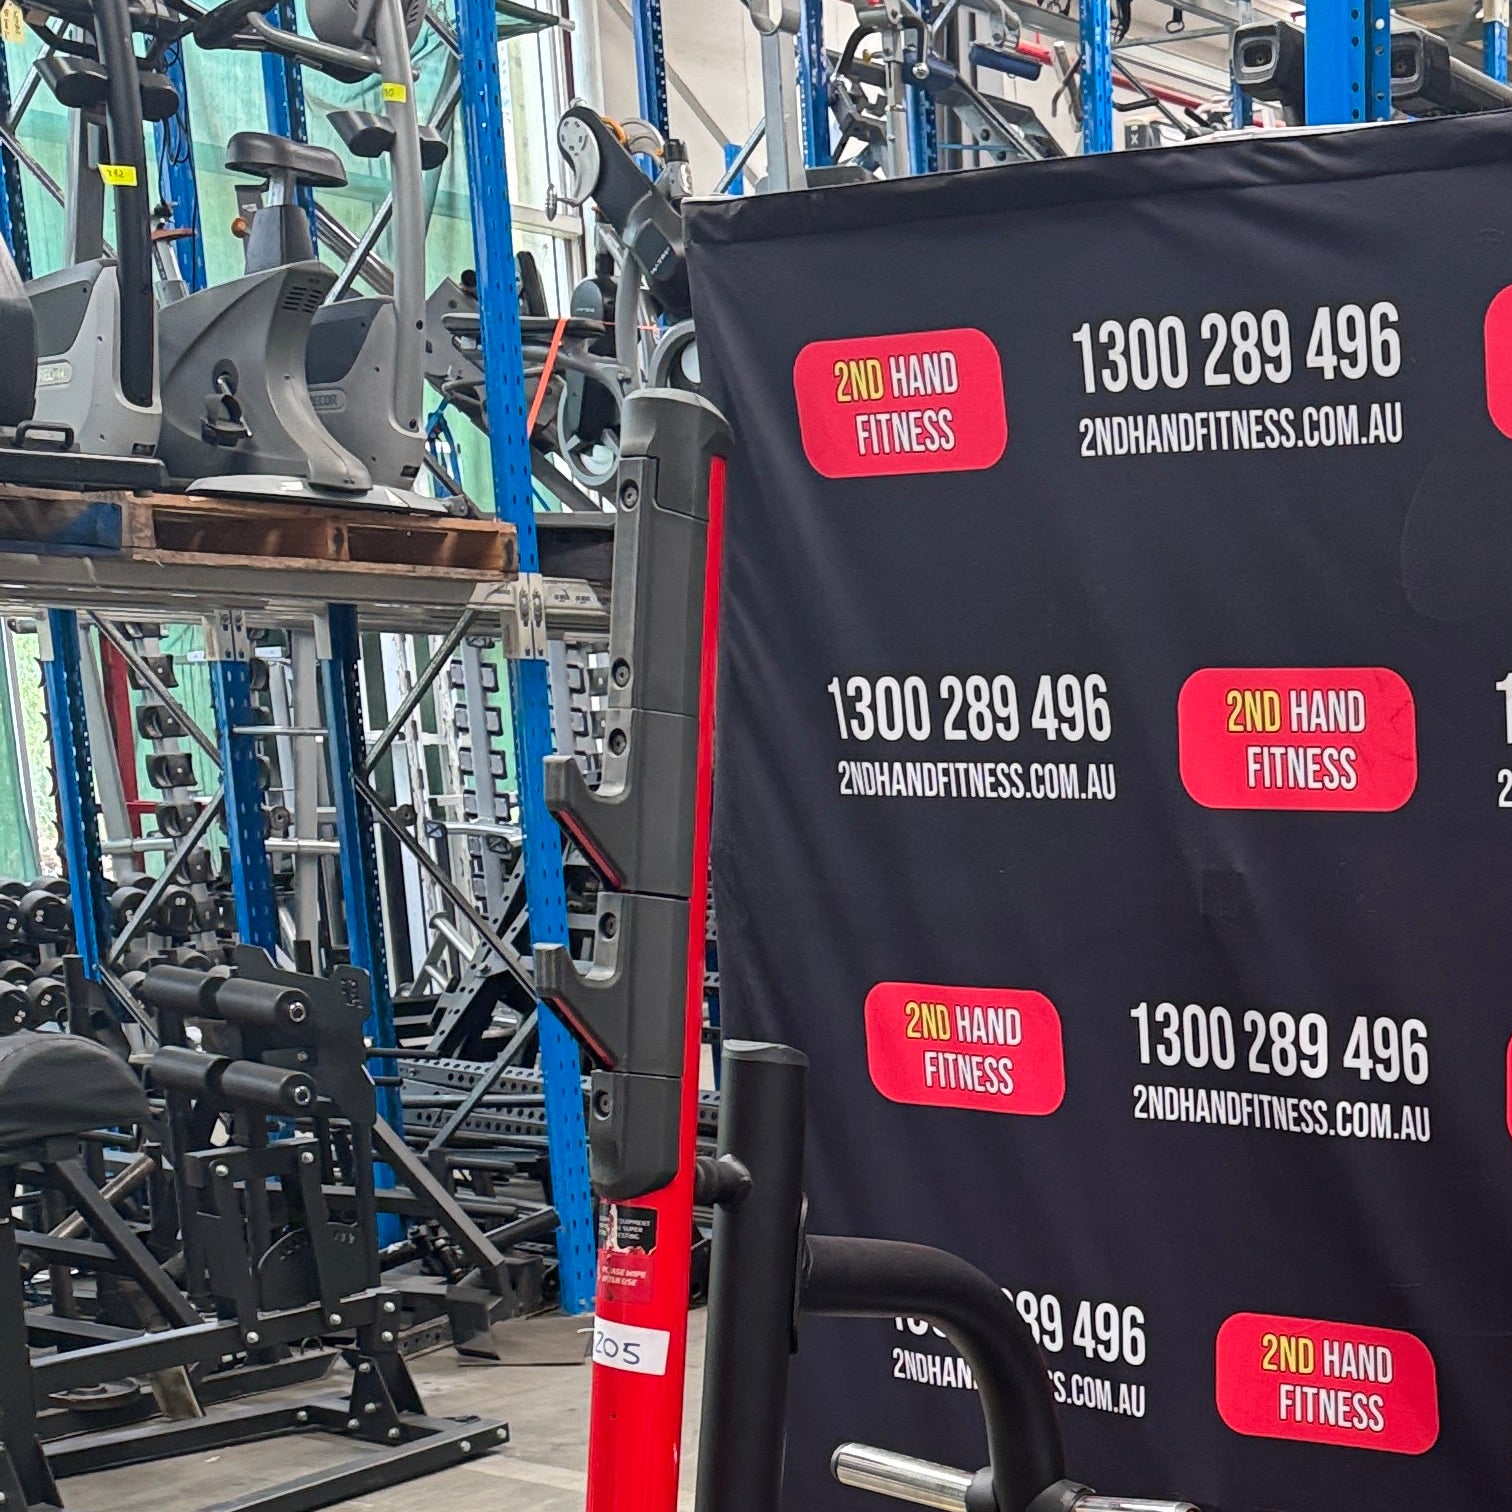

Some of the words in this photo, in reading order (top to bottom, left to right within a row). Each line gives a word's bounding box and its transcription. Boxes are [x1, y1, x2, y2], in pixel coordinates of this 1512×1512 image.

[1072, 315, 1189, 394] 1300
[1200, 308, 1292, 386] 289
[1305, 301, 1401, 380] 496
[834, 359, 884, 402] 2ND
[889, 351, 959, 398] HAND
[855, 408, 955, 455] FITNESS
[1078, 401, 1403, 457] 2NDHANDFITNESS.COM.AU
[827, 675, 931, 741] 1300
[939, 674, 1020, 742] 289
[1031, 673, 1112, 742] 496
[1226, 690, 1281, 732] 2ND
[1289, 690, 1366, 732] HAND
[837, 760, 1116, 801] 2NDHANDFITNESS.COM.AU
[1247, 746, 1357, 790] FITNESS
[905, 1001, 951, 1041] 2ND
[955, 1005, 1022, 1046] HAND
[1130, 1001, 1236, 1070] 1300
[1243, 1009, 1329, 1079] 289
[1342, 1015, 1429, 1085] 496
[924, 1051, 1014, 1095] FITNESS
[1133, 1084, 1431, 1142] 2NDHANDFITNESS.COM.AU
[621, 1278, 638, 1287] USE
[1001, 1287, 1064, 1353] 89
[1072, 1300, 1146, 1366] 496
[1262, 1333, 1314, 1374] 2ND
[1323, 1339, 1393, 1384] HAND
[1280, 1383, 1384, 1432] FITNESS
